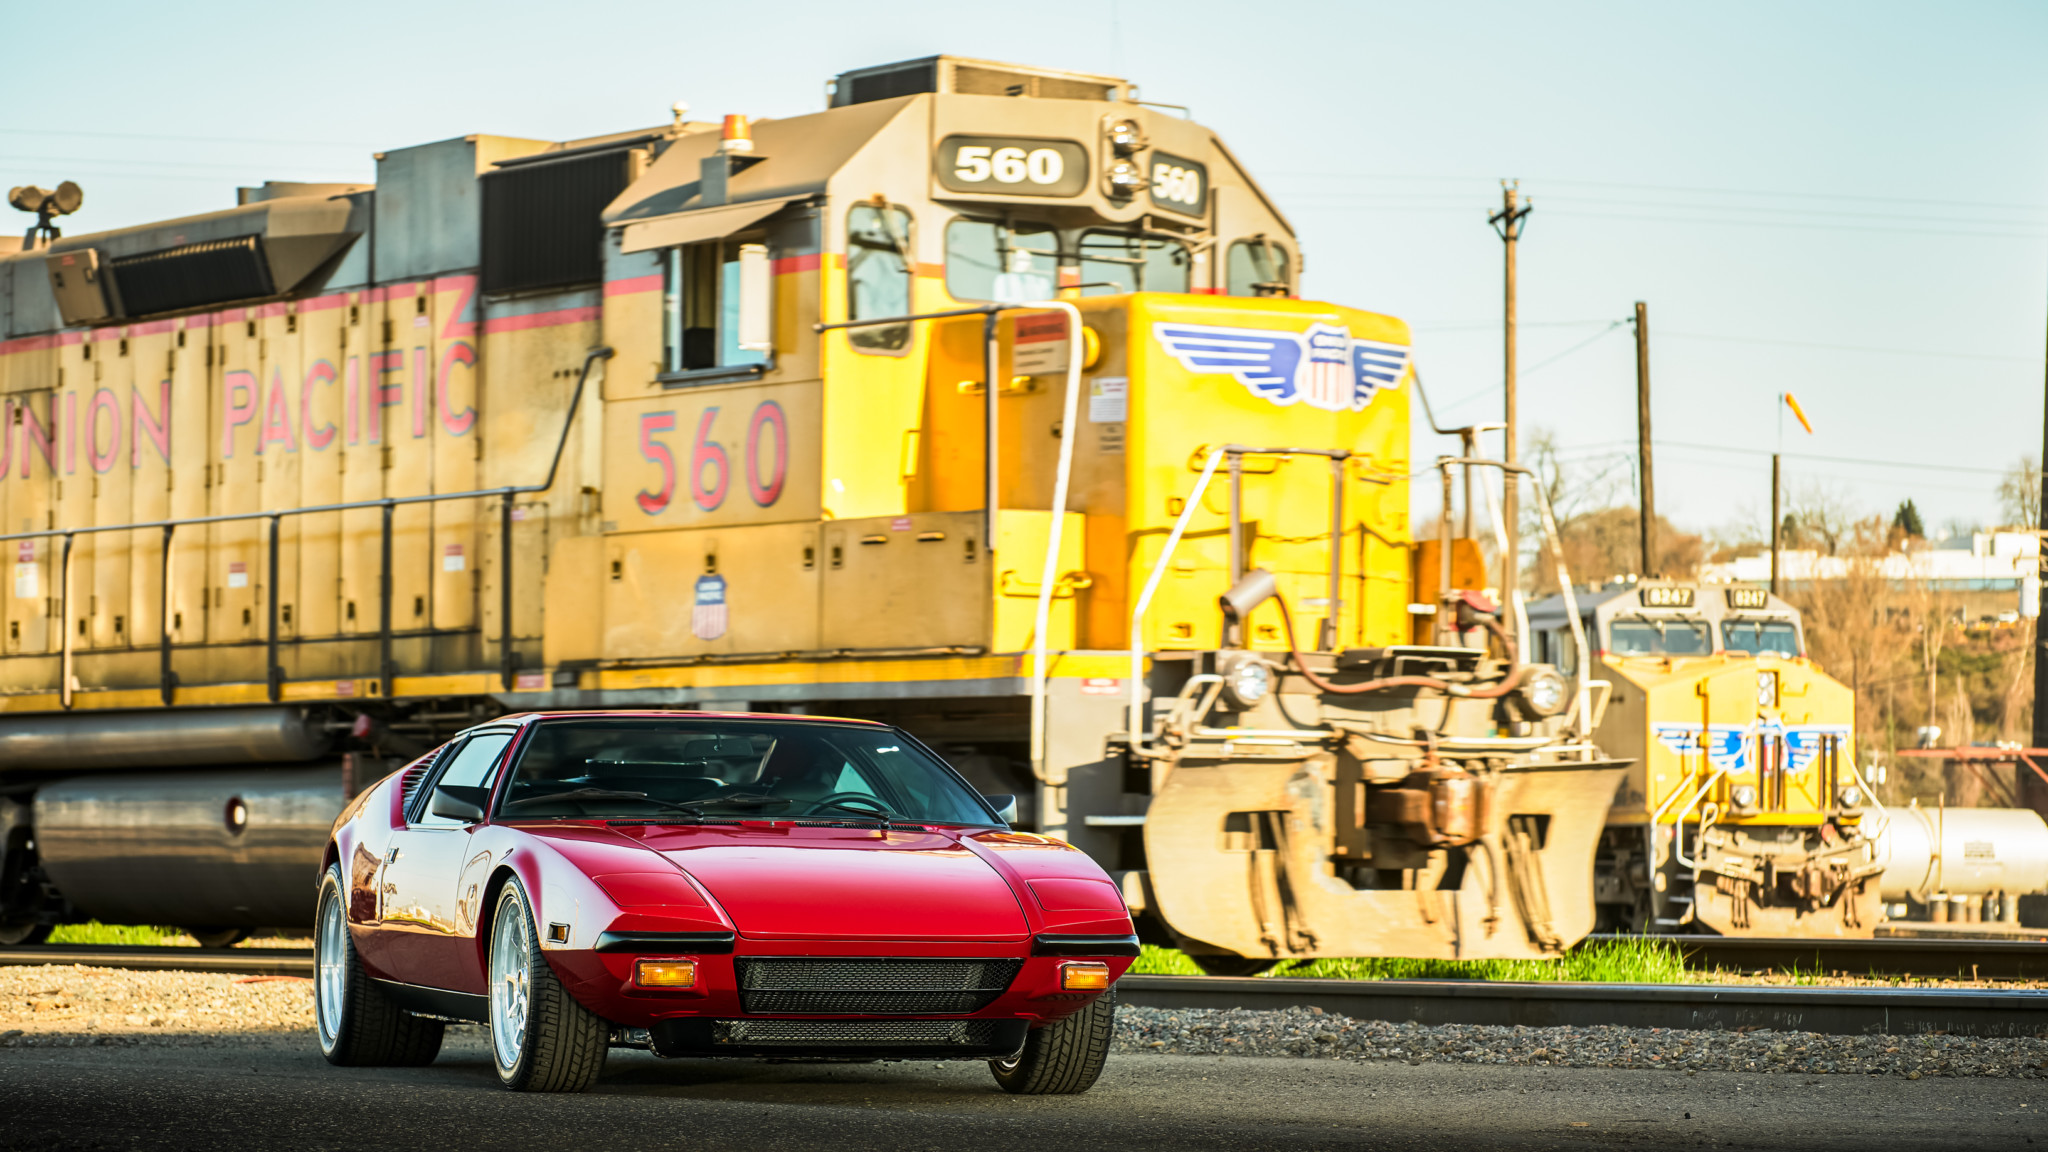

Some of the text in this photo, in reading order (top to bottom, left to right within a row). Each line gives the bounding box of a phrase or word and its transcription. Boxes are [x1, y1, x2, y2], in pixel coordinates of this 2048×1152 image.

[954, 145, 1064, 185] 560
[1151, 162, 1200, 206] 560
[223, 340, 478, 459] PACIFIC
[634, 399, 788, 516] 560
